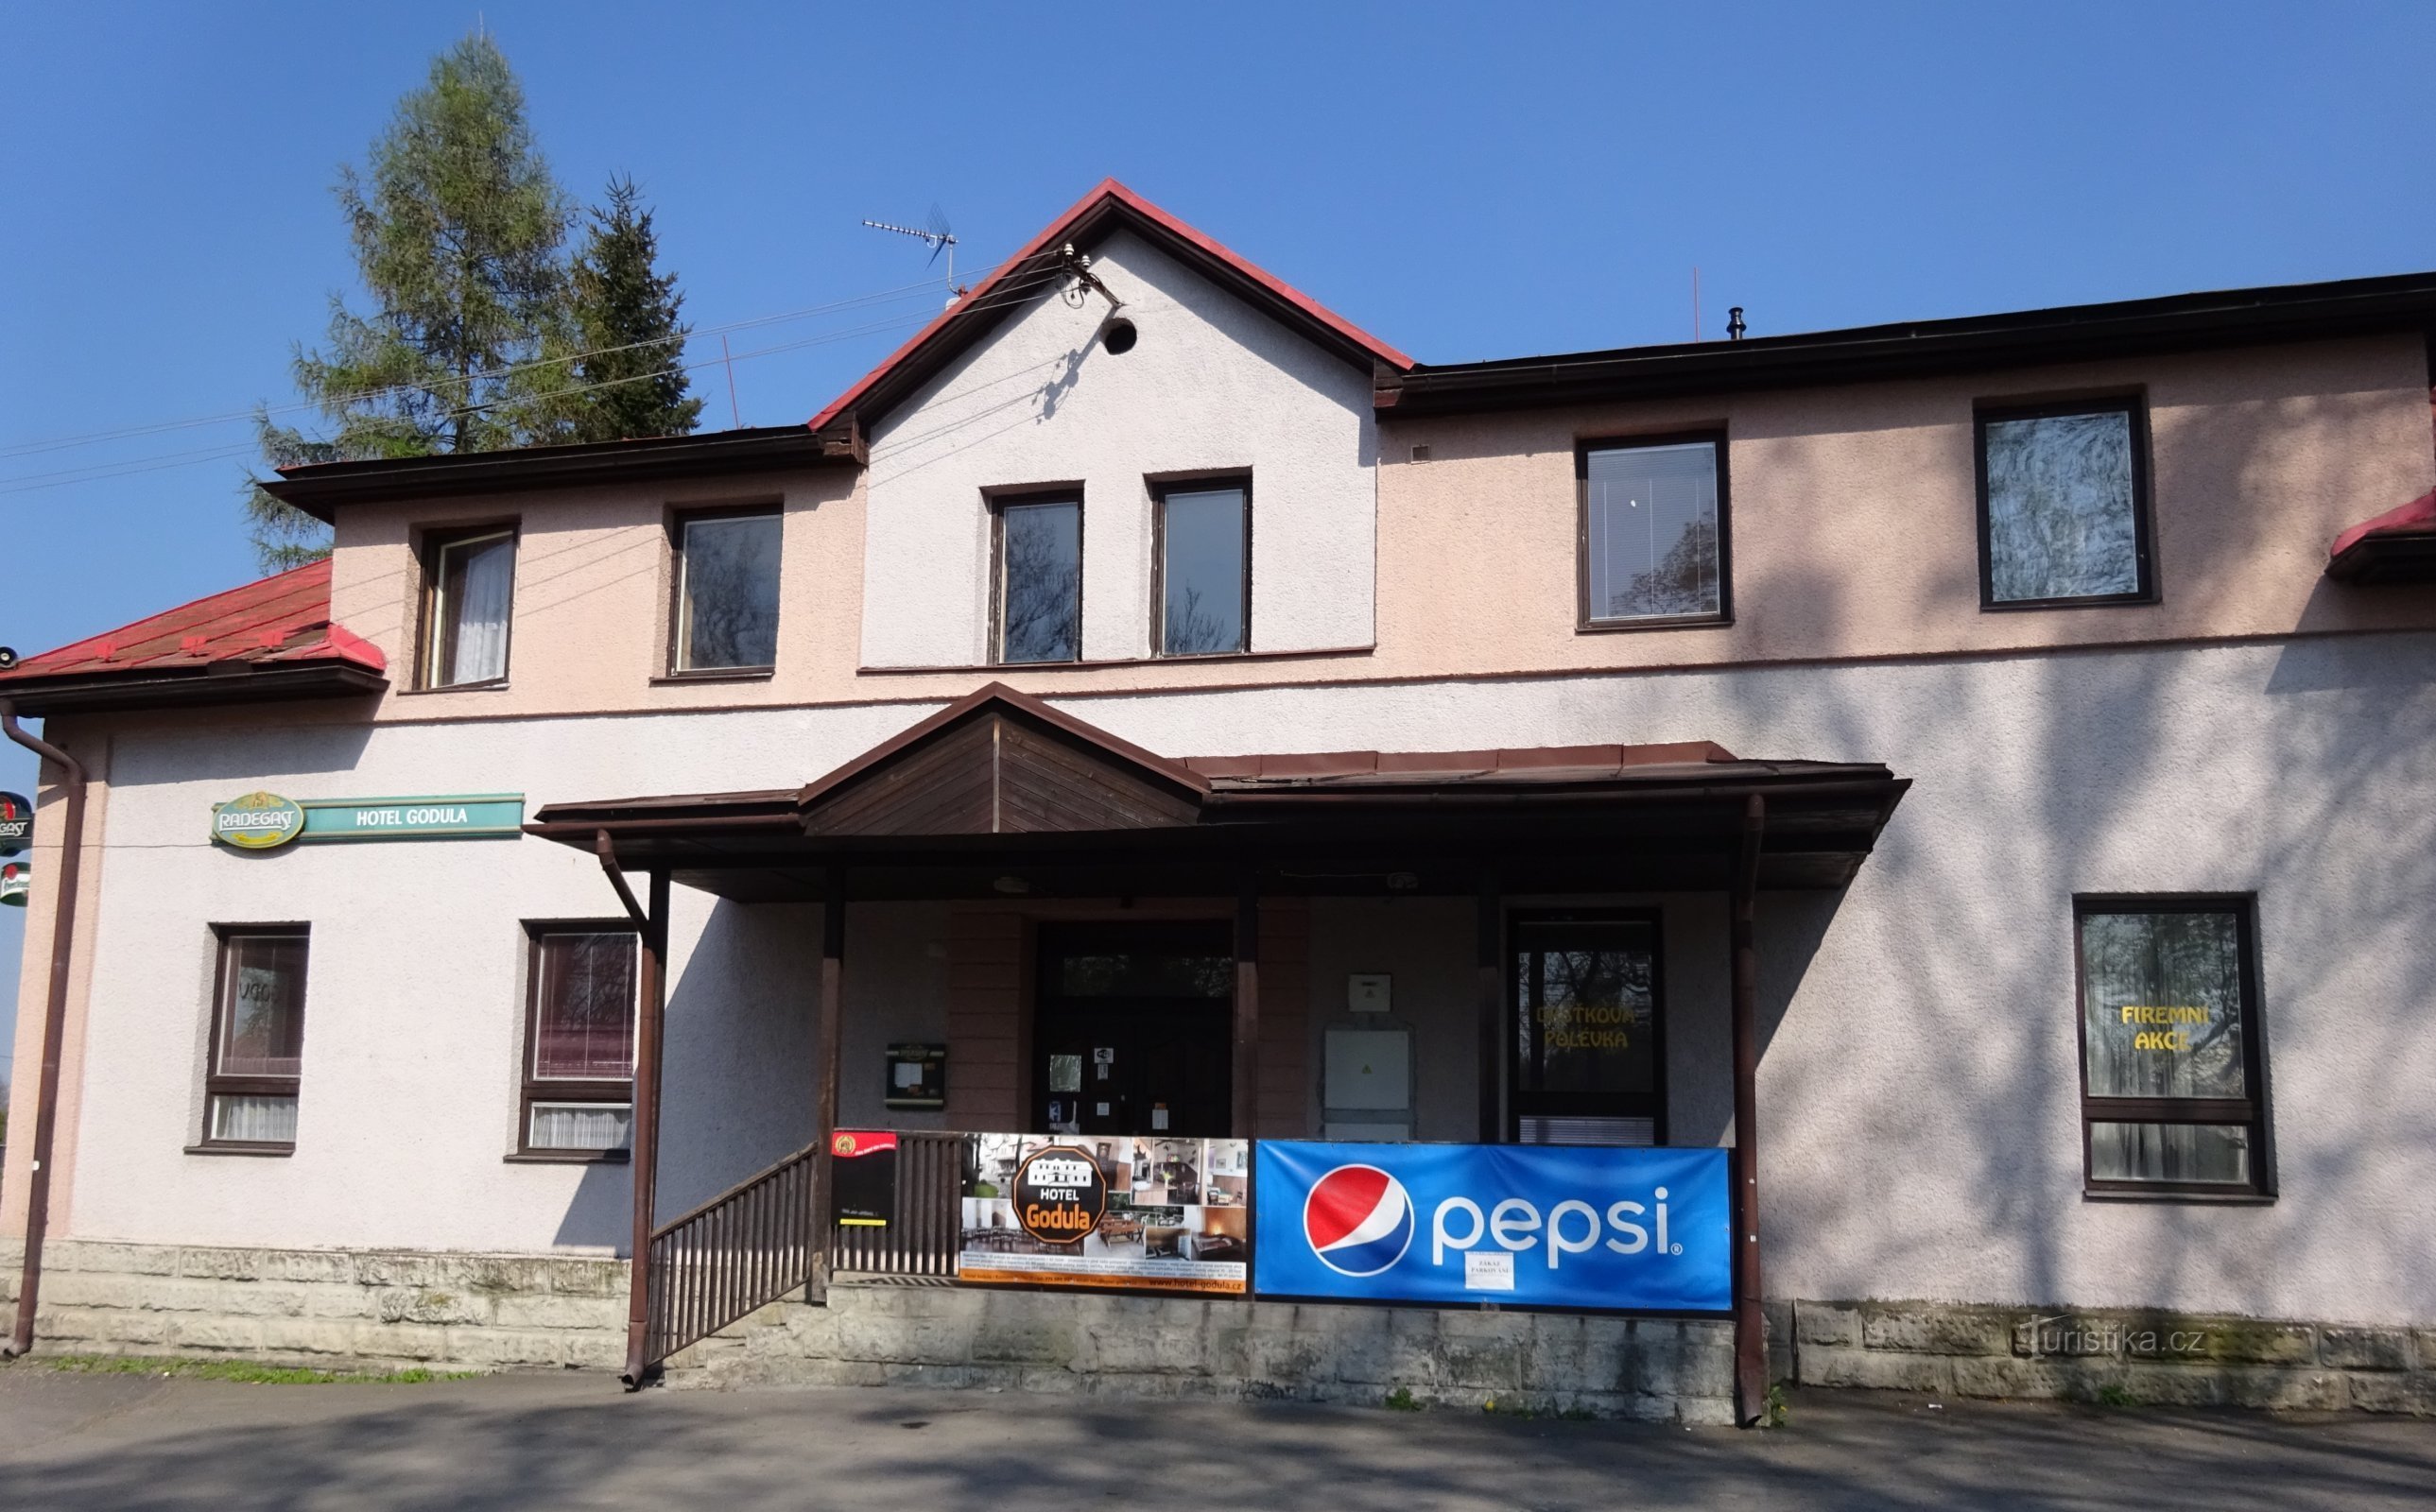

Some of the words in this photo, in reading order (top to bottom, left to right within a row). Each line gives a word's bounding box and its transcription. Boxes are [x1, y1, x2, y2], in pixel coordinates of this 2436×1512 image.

[218, 810, 295, 832] RADEGAST
[356, 810, 403, 826] HOTEL
[406, 808, 468, 825] GODULA
[0, 822, 27, 836] GAST
[1544, 1026, 1629, 1048] POLÉVKA
[2134, 1030, 2192, 1051] AKCE
[1040, 1188, 1080, 1201] HOTEL
[1026, 1203, 1091, 1229] Godula
[1432, 1186, 1669, 1269] pepsi
[1149, 1278, 1242, 1291] www.hotel-godula.cz
